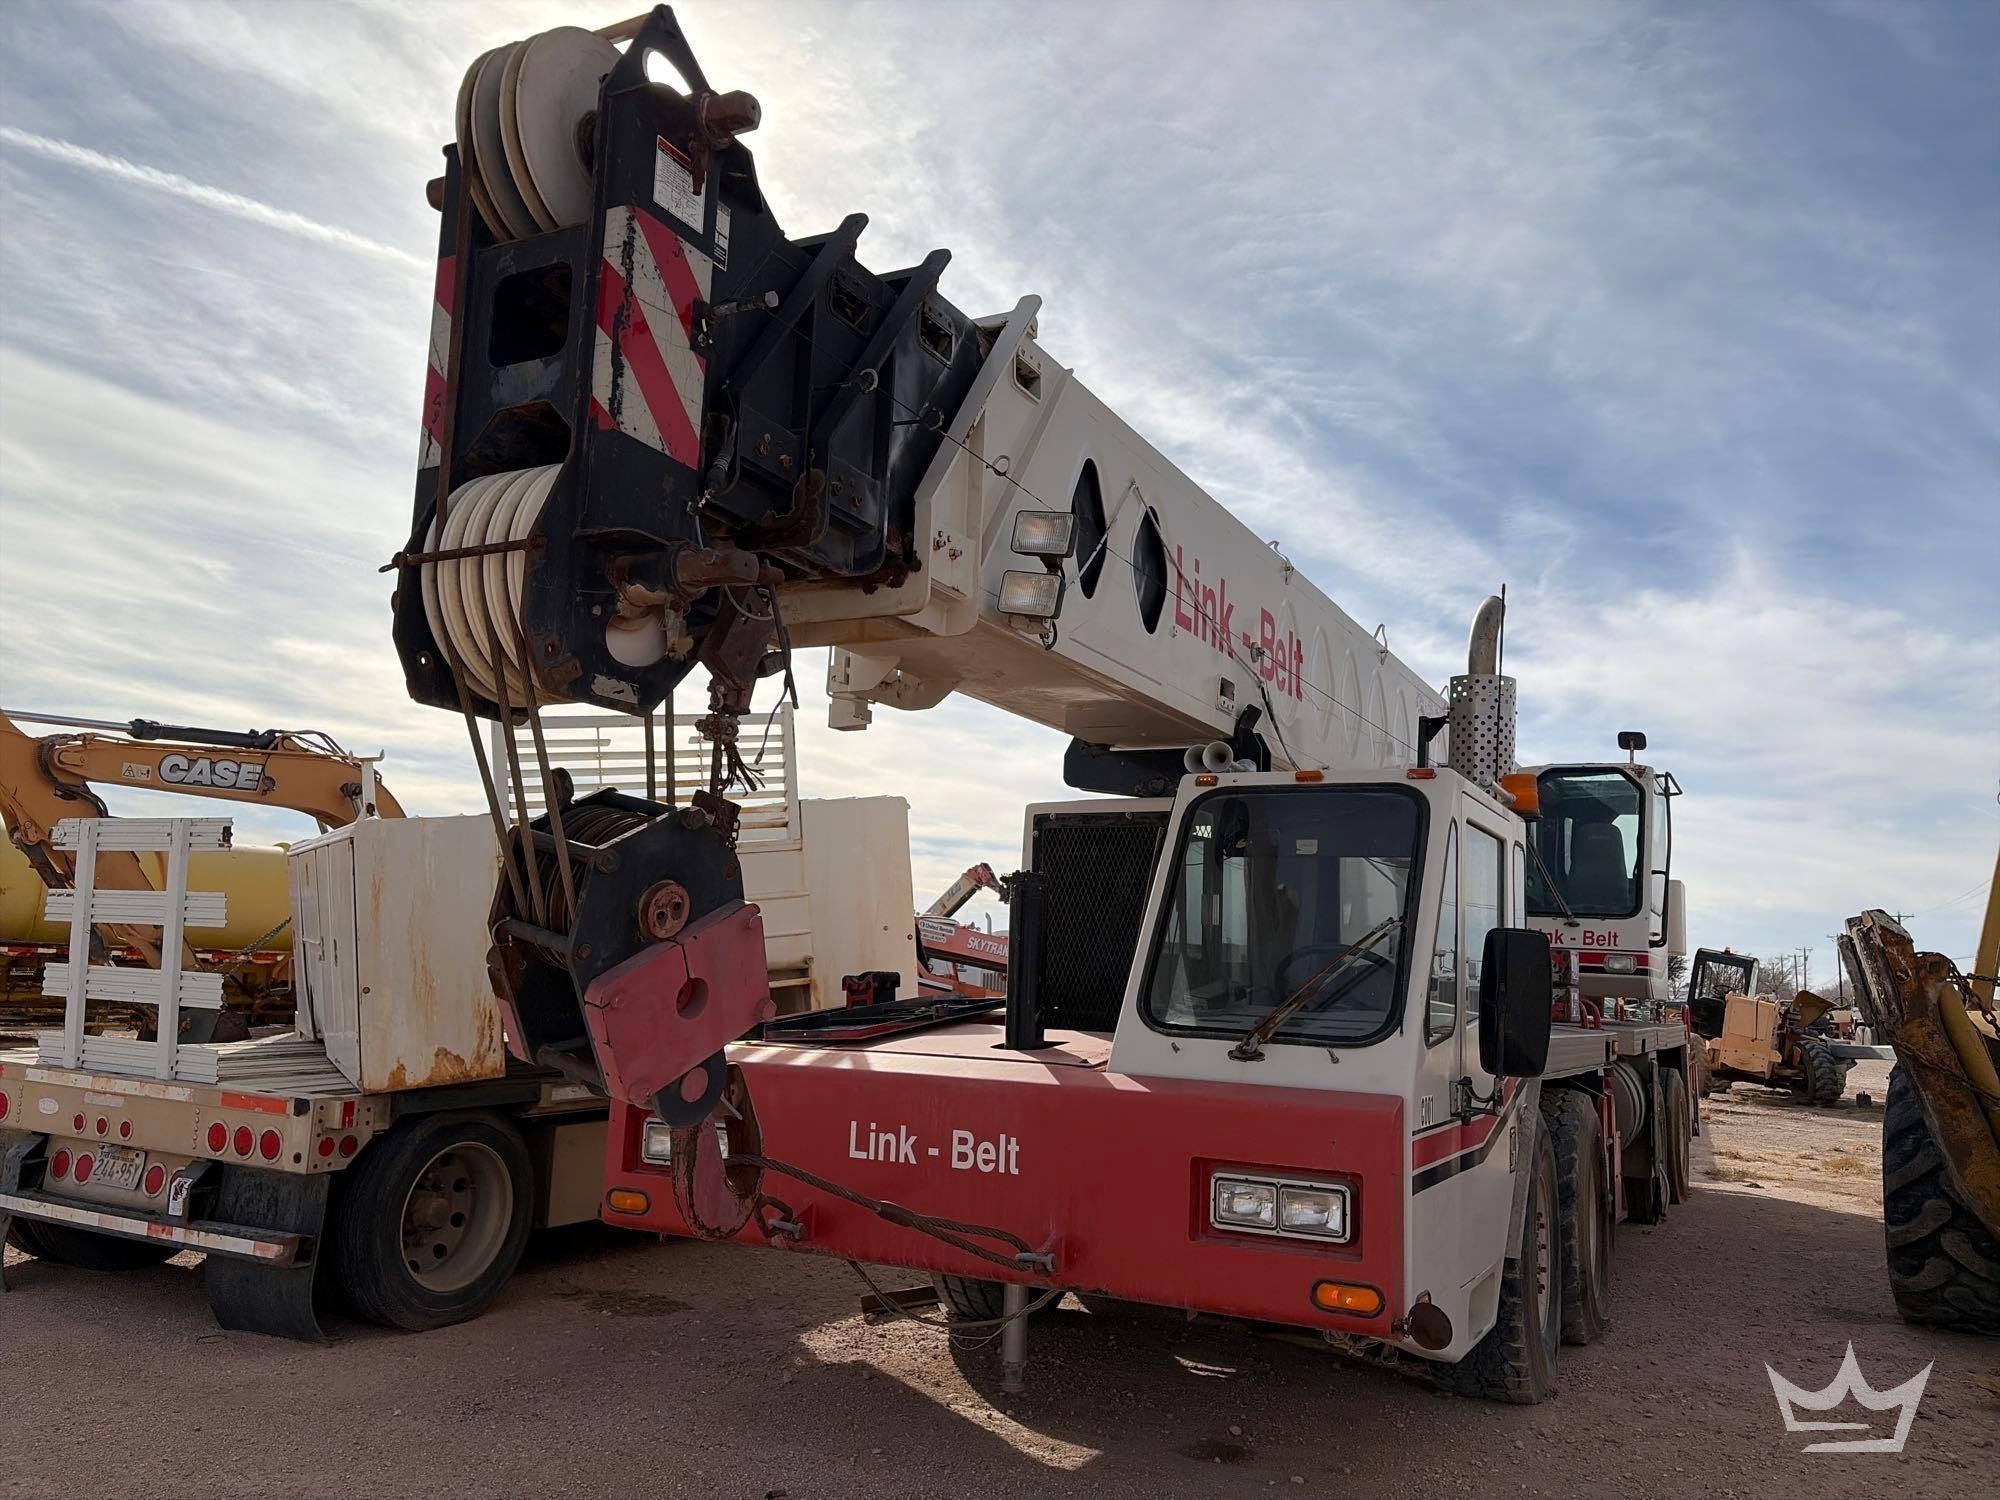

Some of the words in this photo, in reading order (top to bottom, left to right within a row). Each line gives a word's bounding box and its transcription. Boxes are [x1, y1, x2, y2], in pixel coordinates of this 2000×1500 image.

[1175, 543, 1234, 660] Link
[1259, 607, 1304, 703] Belt
[159, 753, 264, 790] CASE
[1582, 930, 1619, 947] Belt
[849, 1120, 918, 1164] Link
[951, 1129, 1020, 1175] Belt
